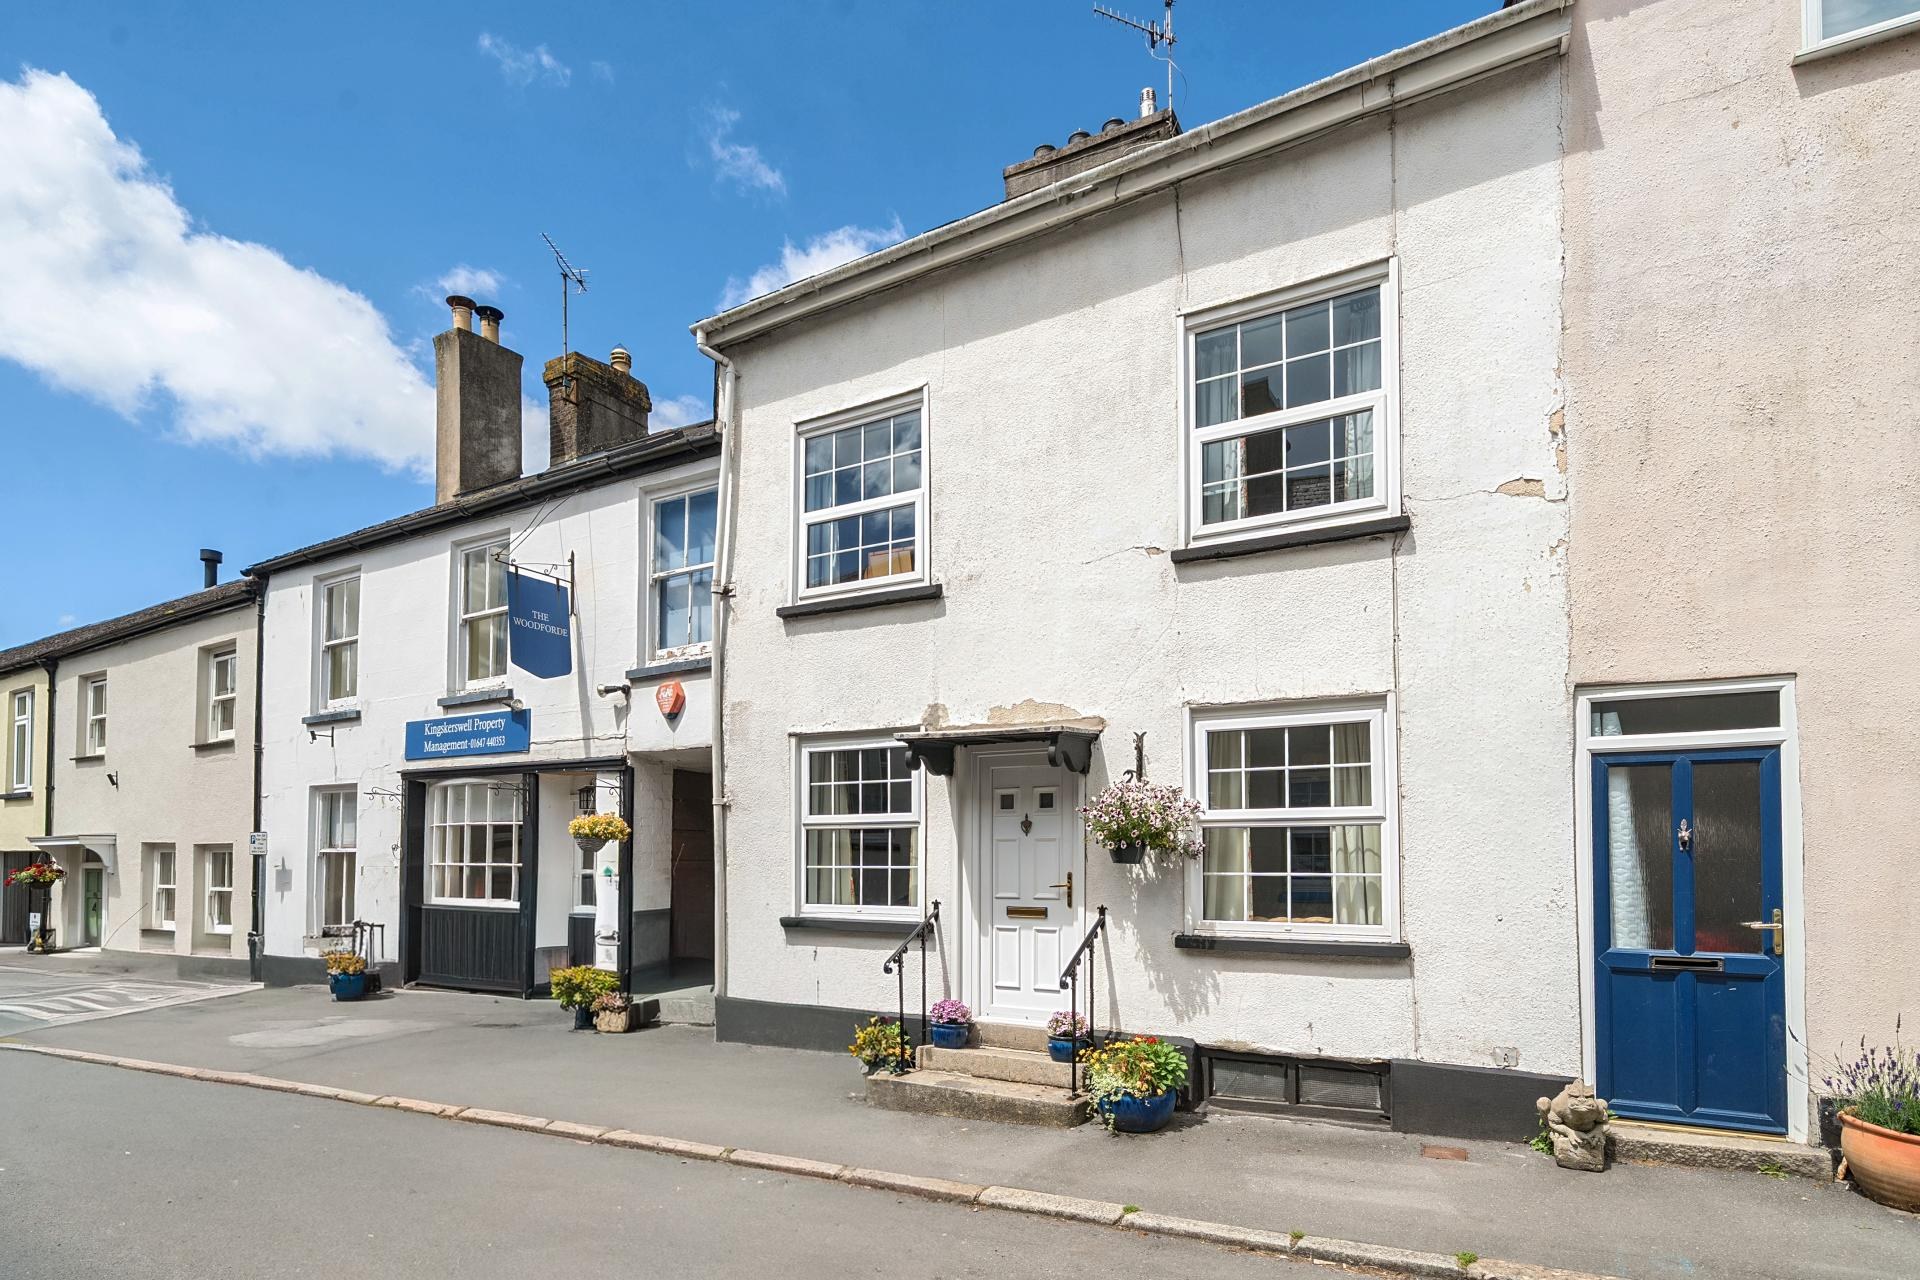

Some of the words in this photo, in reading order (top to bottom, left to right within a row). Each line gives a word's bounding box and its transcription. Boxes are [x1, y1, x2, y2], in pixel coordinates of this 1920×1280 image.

[531, 610, 550, 622] THE
[512, 616, 568, 637] WOODFORDE
[424, 718, 473, 737] Kingskerswell
[474, 717, 506, 733] Property
[486, 735, 506, 747] 440353
